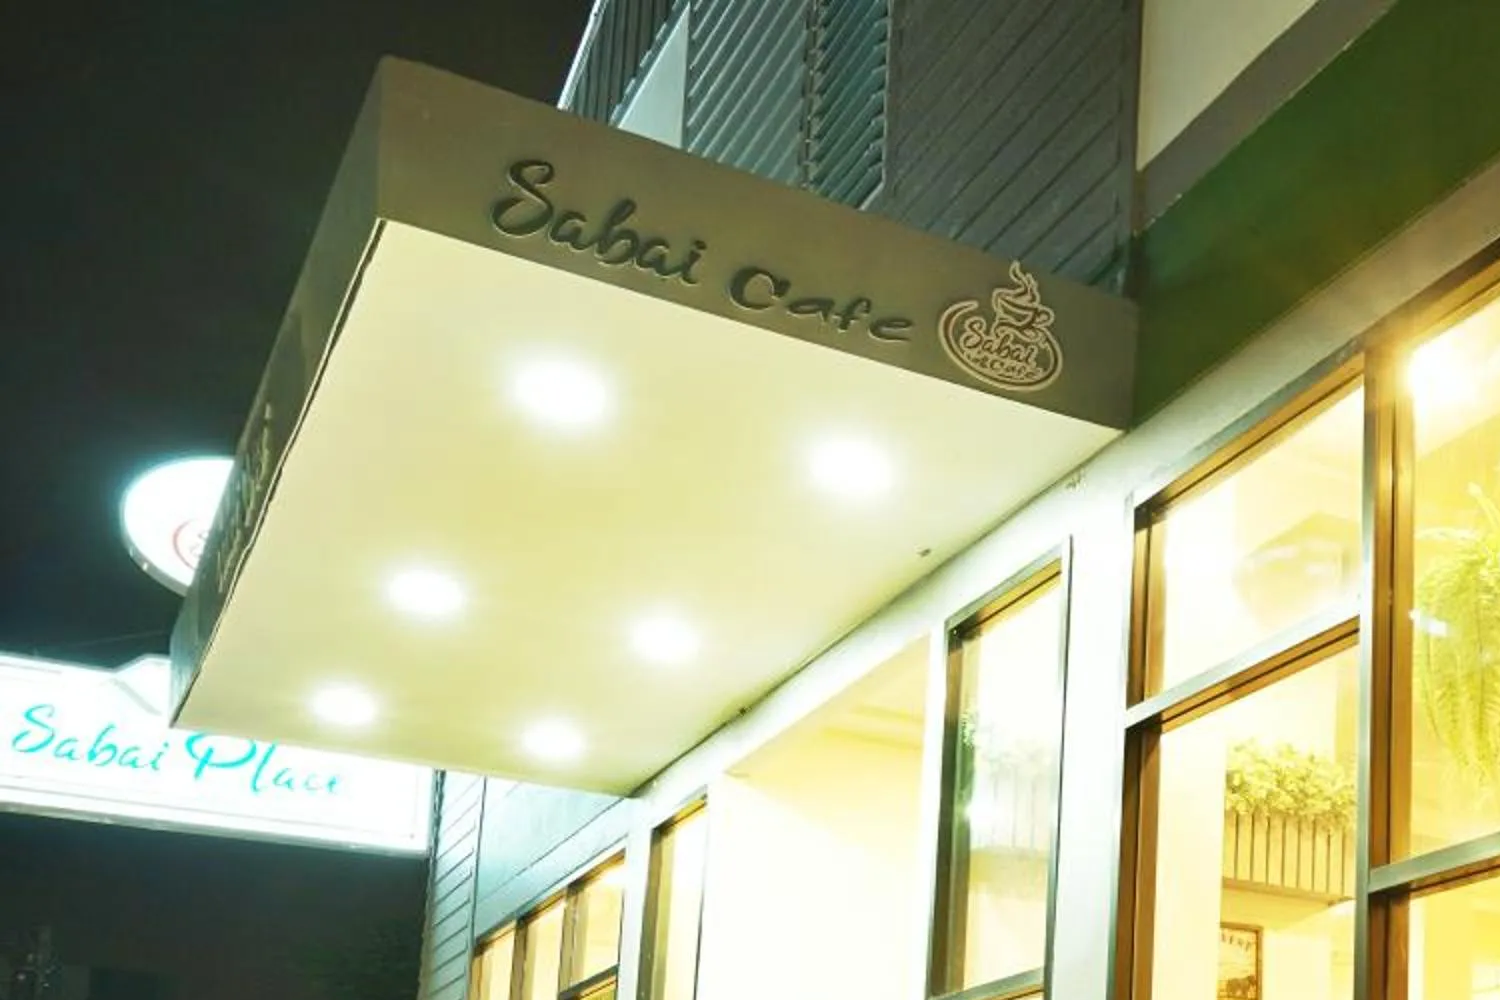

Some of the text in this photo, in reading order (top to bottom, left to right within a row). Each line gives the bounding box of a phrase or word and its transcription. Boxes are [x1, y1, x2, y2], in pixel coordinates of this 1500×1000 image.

[491, 158, 914, 343] Sabai Cafe
[961, 317, 1037, 365] Sabai
[11, 703, 170, 772] Sabai
